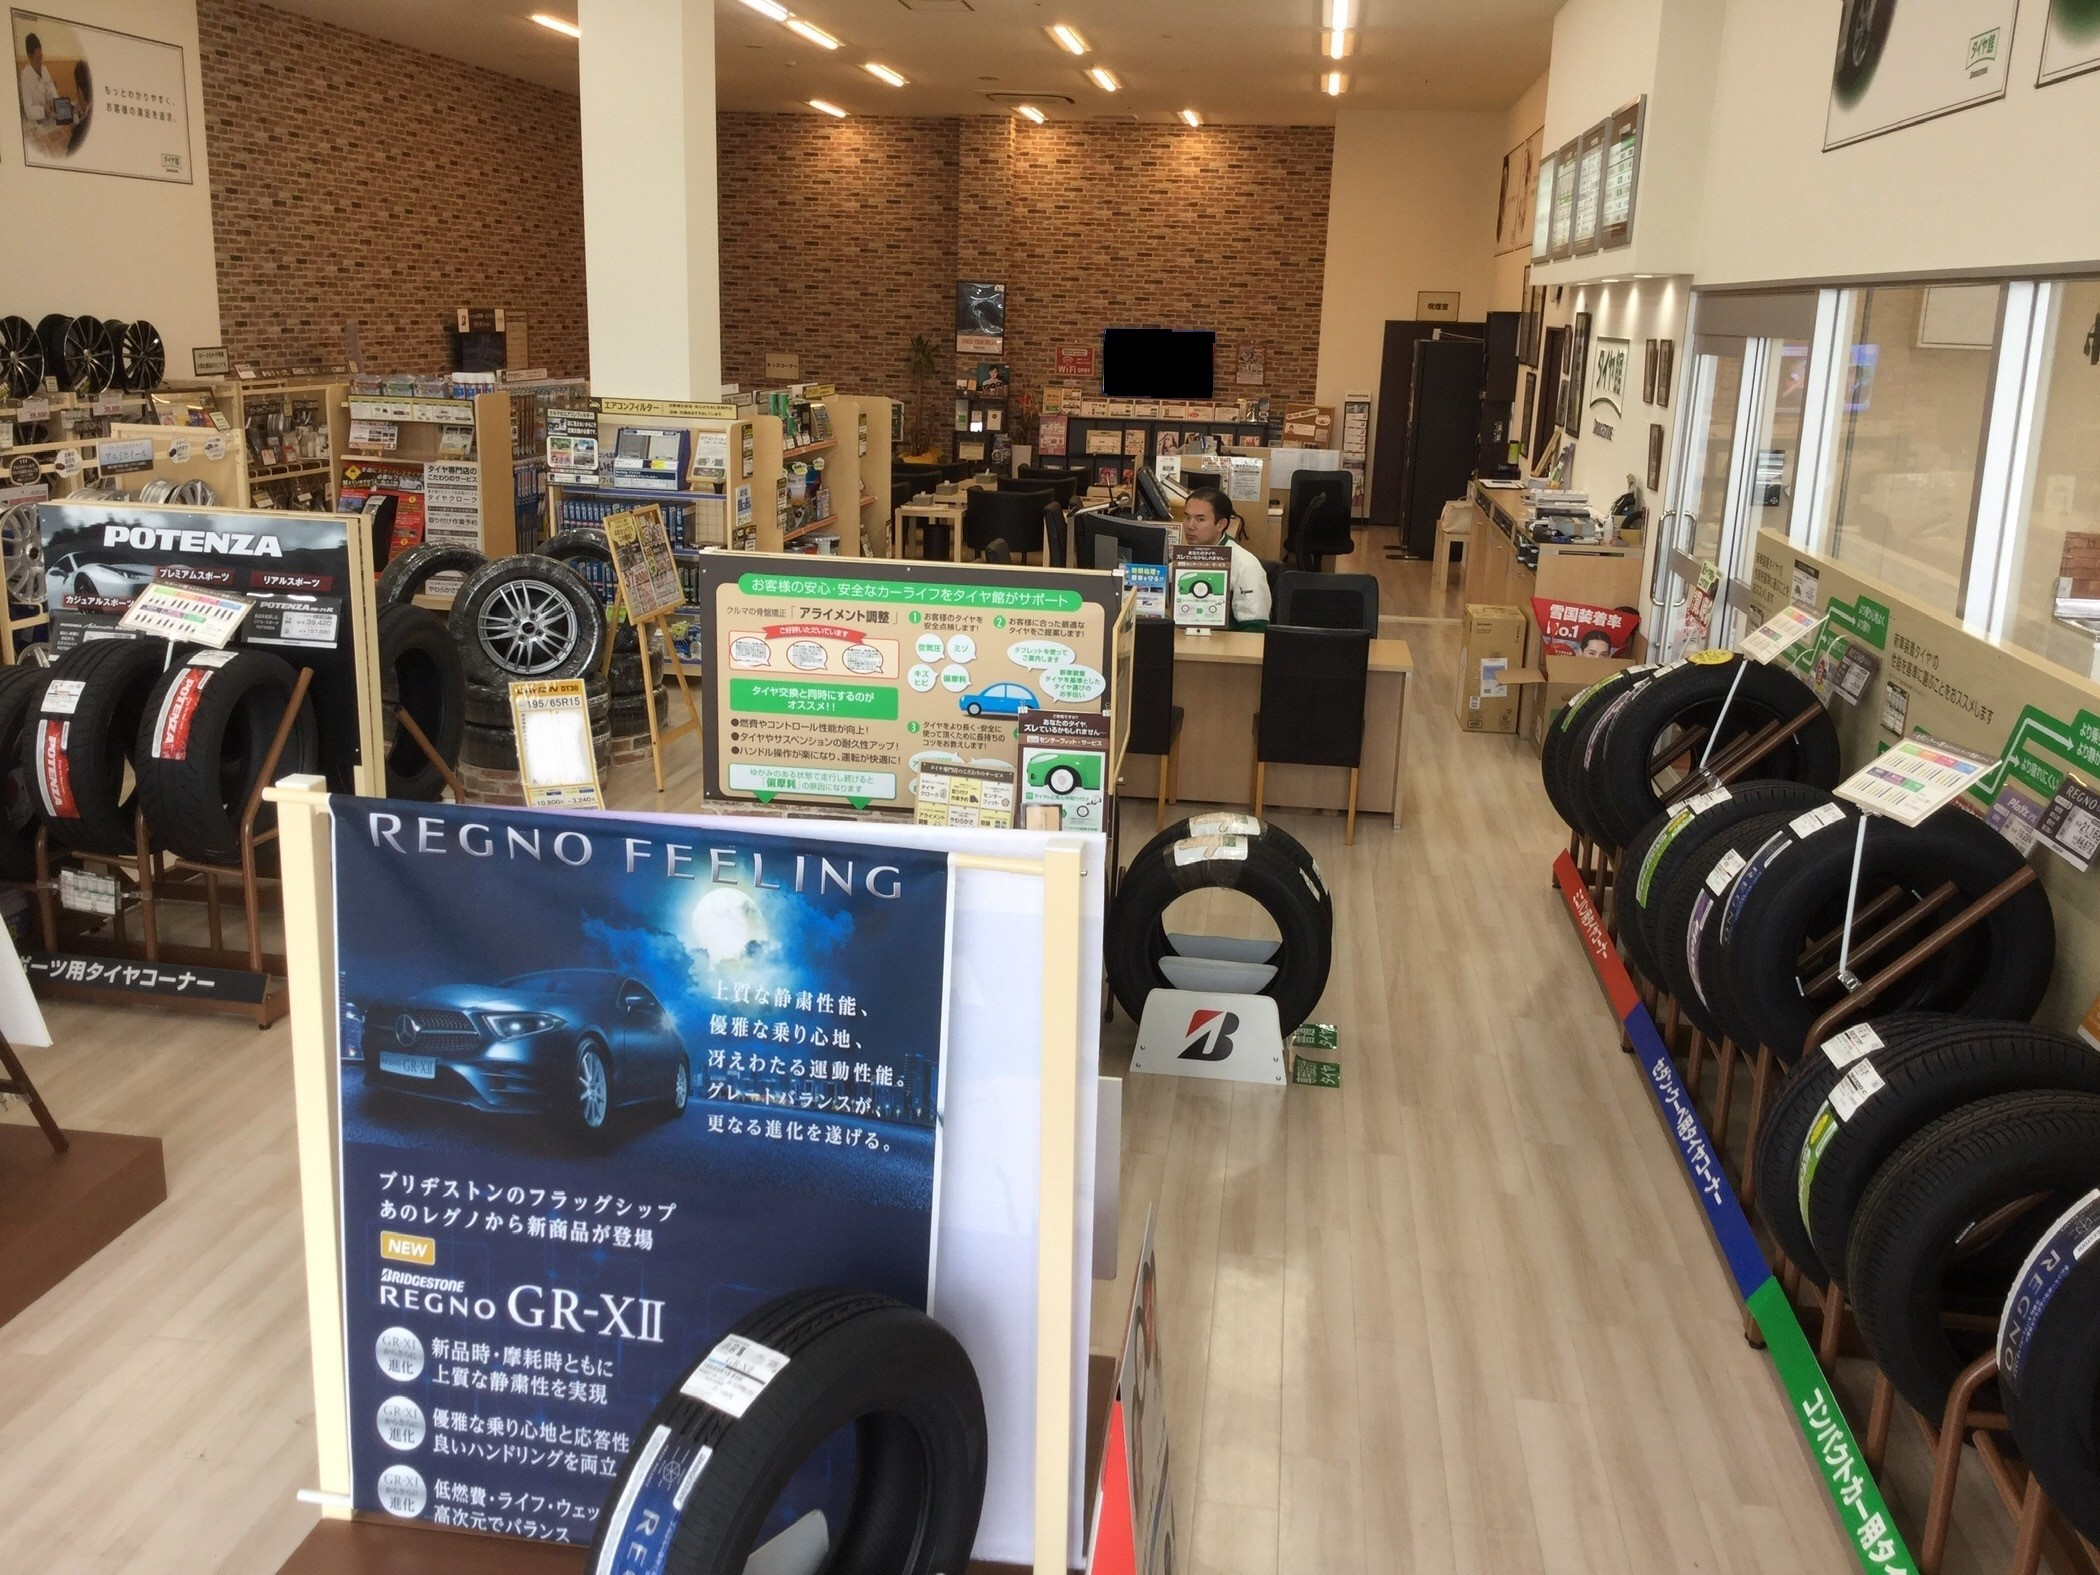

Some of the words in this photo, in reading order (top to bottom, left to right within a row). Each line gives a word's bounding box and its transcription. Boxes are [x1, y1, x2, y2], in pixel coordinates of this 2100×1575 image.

[1970, 33, 1996, 60] タイヤ館
[104, 85, 177, 107] もっとわかりやすく、
[1427, 302, 1450, 311] 喫煙室
[1057, 365, 1077, 374] WiFi
[603, 401, 660, 413] エアコンフィルター
[427, 465, 478, 475] タイヤ専門店の
[427, 473, 478, 483] こだわりのサービス
[427, 494, 478, 504] タイヤクローク
[103, 524, 283, 558] POTENZA
[159, 568, 230, 582] プレミアムスポーツ
[263, 575, 320, 588] リアルスポーツ
[751, 578, 1069, 608] お客様の安心・安全なカーライフをタイヤ館がサポート
[64, 594, 136, 608] カジュアルスポーツ
[259, 601, 311, 612] POTENZA
[726, 605, 787, 619] クルマの骨盤矯正
[923, 612, 983, 624] お客様のタイヤを
[1549, 603, 1623, 630] 雪国装着率
[923, 622, 980, 632] 安全点検します!
[1008, 617, 1086, 630] お客様に合った最適な
[779, 626, 849, 638] ご好評いただいています
[1008, 626, 1085, 638] タイヤをご提案します!
[918, 643, 942, 653] 空気圧
[953, 644, 969, 654] ミゾ
[1013, 645, 1068, 657] タブレットを使って
[1022, 654, 1059, 663] ご案内します
[913, 669, 930, 679] キズ
[560, 684, 579, 692] DT30
[913, 678, 930, 687] ヒビ
[751, 685, 875, 704] タイヤ交換と同時にするのが
[1058, 691, 1086, 700] お手伝い
[527, 697, 581, 709] 195/65R15
[787, 700, 837, 712] オススメ!!
[163, 678, 196, 745] POTENZA
[739, 718, 869, 735] 燃費やコントロール性能が向上!
[922, 720, 1003, 733] タイヤをより長く・安全に
[1042, 718, 1088, 728] あなたのタイヤ、
[739, 732, 900, 751] タイヤやサスペンションの耐久性アップ!
[922, 731, 1006, 743] 使って頂くために長持ちの
[1038, 736, 1103, 747] センターフィット・サービス
[921, 739, 987, 750] コツをお教えします!
[739, 746, 901, 765] ハンドル操作が楽になり、運転が快適に!
[47, 735, 63, 806] POTENZA
[749, 769, 874, 785] ゆがみのある状態で走行し続けると
[929, 764, 1005, 779] タイヤ専門店のこだわりのサービス
[920, 784, 936, 792] タイヤ
[920, 790, 940, 798] クローク
[982, 799, 1000, 807] フィット
[983, 792, 1004, 801] センター
[2065, 785, 2099, 811] REGNO
[918, 811, 947, 821] アライメント
[369, 812, 594, 866] REGNO
[625, 838, 902, 899] FEELING
[711, 979, 870, 1017] 上質な静粛性能、
[709, 1013, 863, 1050] 優雅な乗り心地、
[708, 1049, 905, 1088] 冴えわたる運動性能。
[707, 1081, 882, 1119] グレートバランスが、
[706, 1114, 891, 1153] 更なる進化を遂げる。
[379, 1171, 678, 1223] ブリヂストンのフラッグシップ
[379, 1199, 655, 1251] あのレグノから新商品が登場
[387, 1239, 429, 1258] NEW
[380, 1267, 465, 1293] BRIDGESTONE
[379, 1286, 497, 1321] REGNO
[506, 1284, 666, 1343] GR-XII
[2003, 1248, 2062, 1372] REGNO
[431, 1337, 614, 1378] 新品時・摩耗時ともに
[387, 1358, 415, 1375] 進化
[432, 1367, 608, 1406] 上質な静粛性を実現
[388, 1427, 416, 1444] 進化
[433, 1407, 630, 1454] 優雅な乗り心地と応答性
[433, 1434, 618, 1478] 良いハンドリングを両立
[389, 1495, 417, 1512] 進化
[434, 1504, 570, 1544] 高次元でバランス
[621, 1508, 661, 1575] RE
